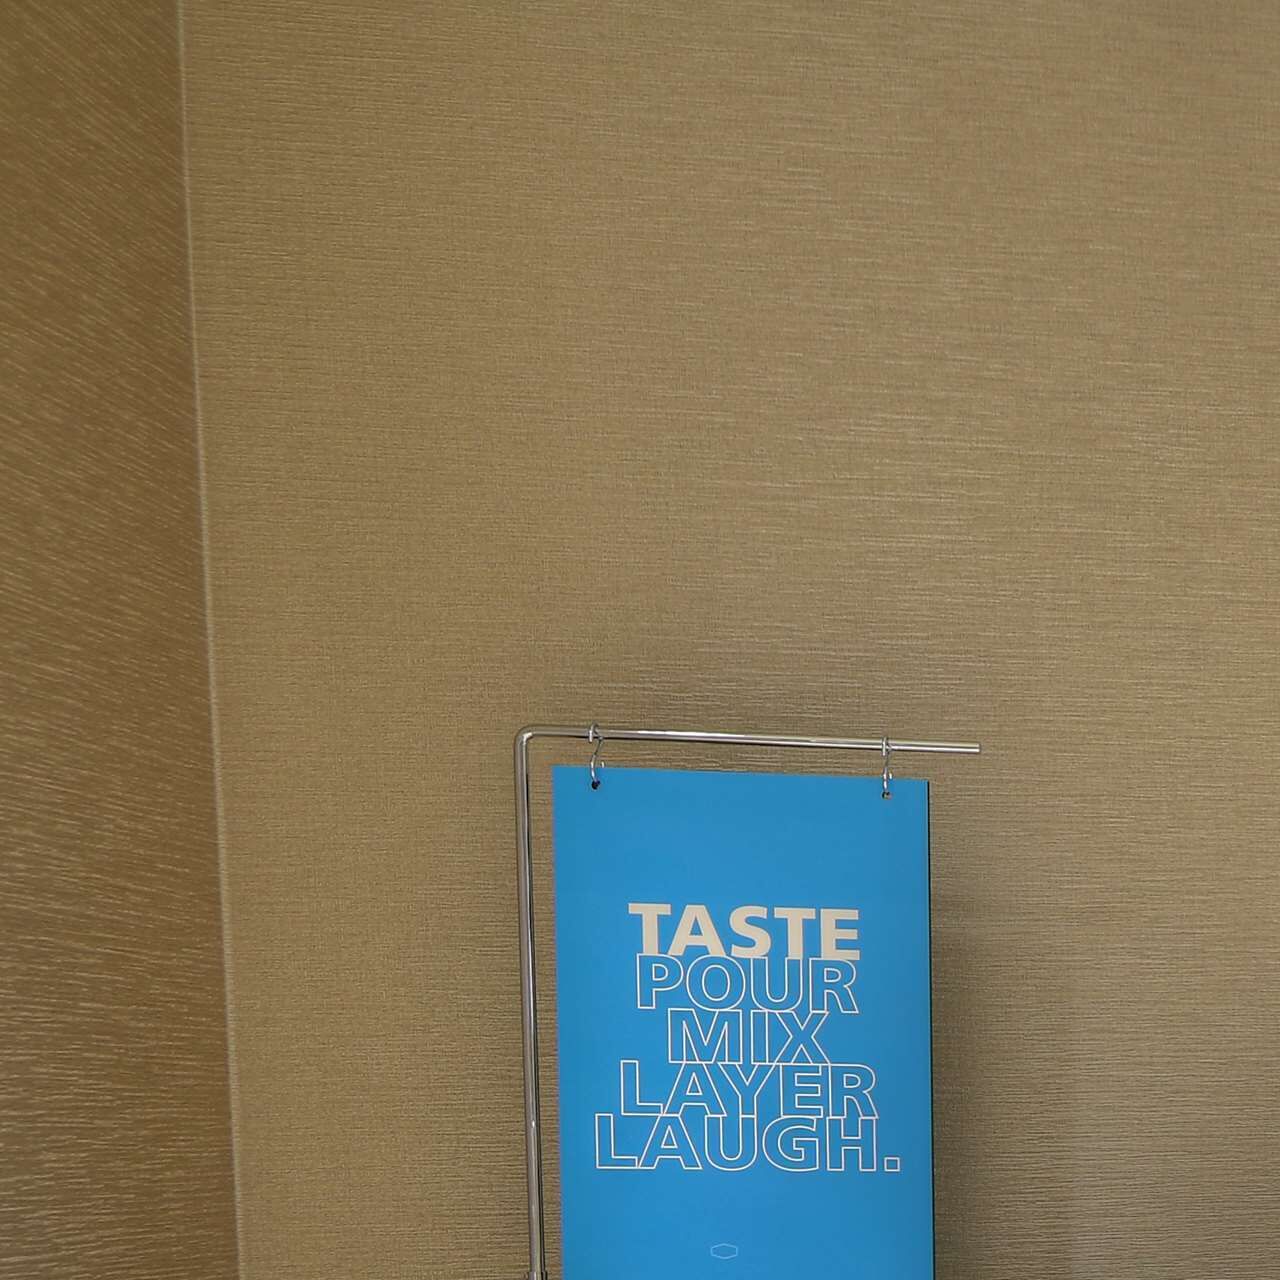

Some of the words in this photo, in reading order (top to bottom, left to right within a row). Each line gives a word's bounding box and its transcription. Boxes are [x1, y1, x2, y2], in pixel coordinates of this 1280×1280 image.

[627, 902, 861, 961] TASTE
[636, 953, 860, 1014] POUR
[667, 1007, 831, 1065] MIX
[620, 1059, 880, 1119] LAYER
[594, 1112, 901, 1172] LAUGH.
